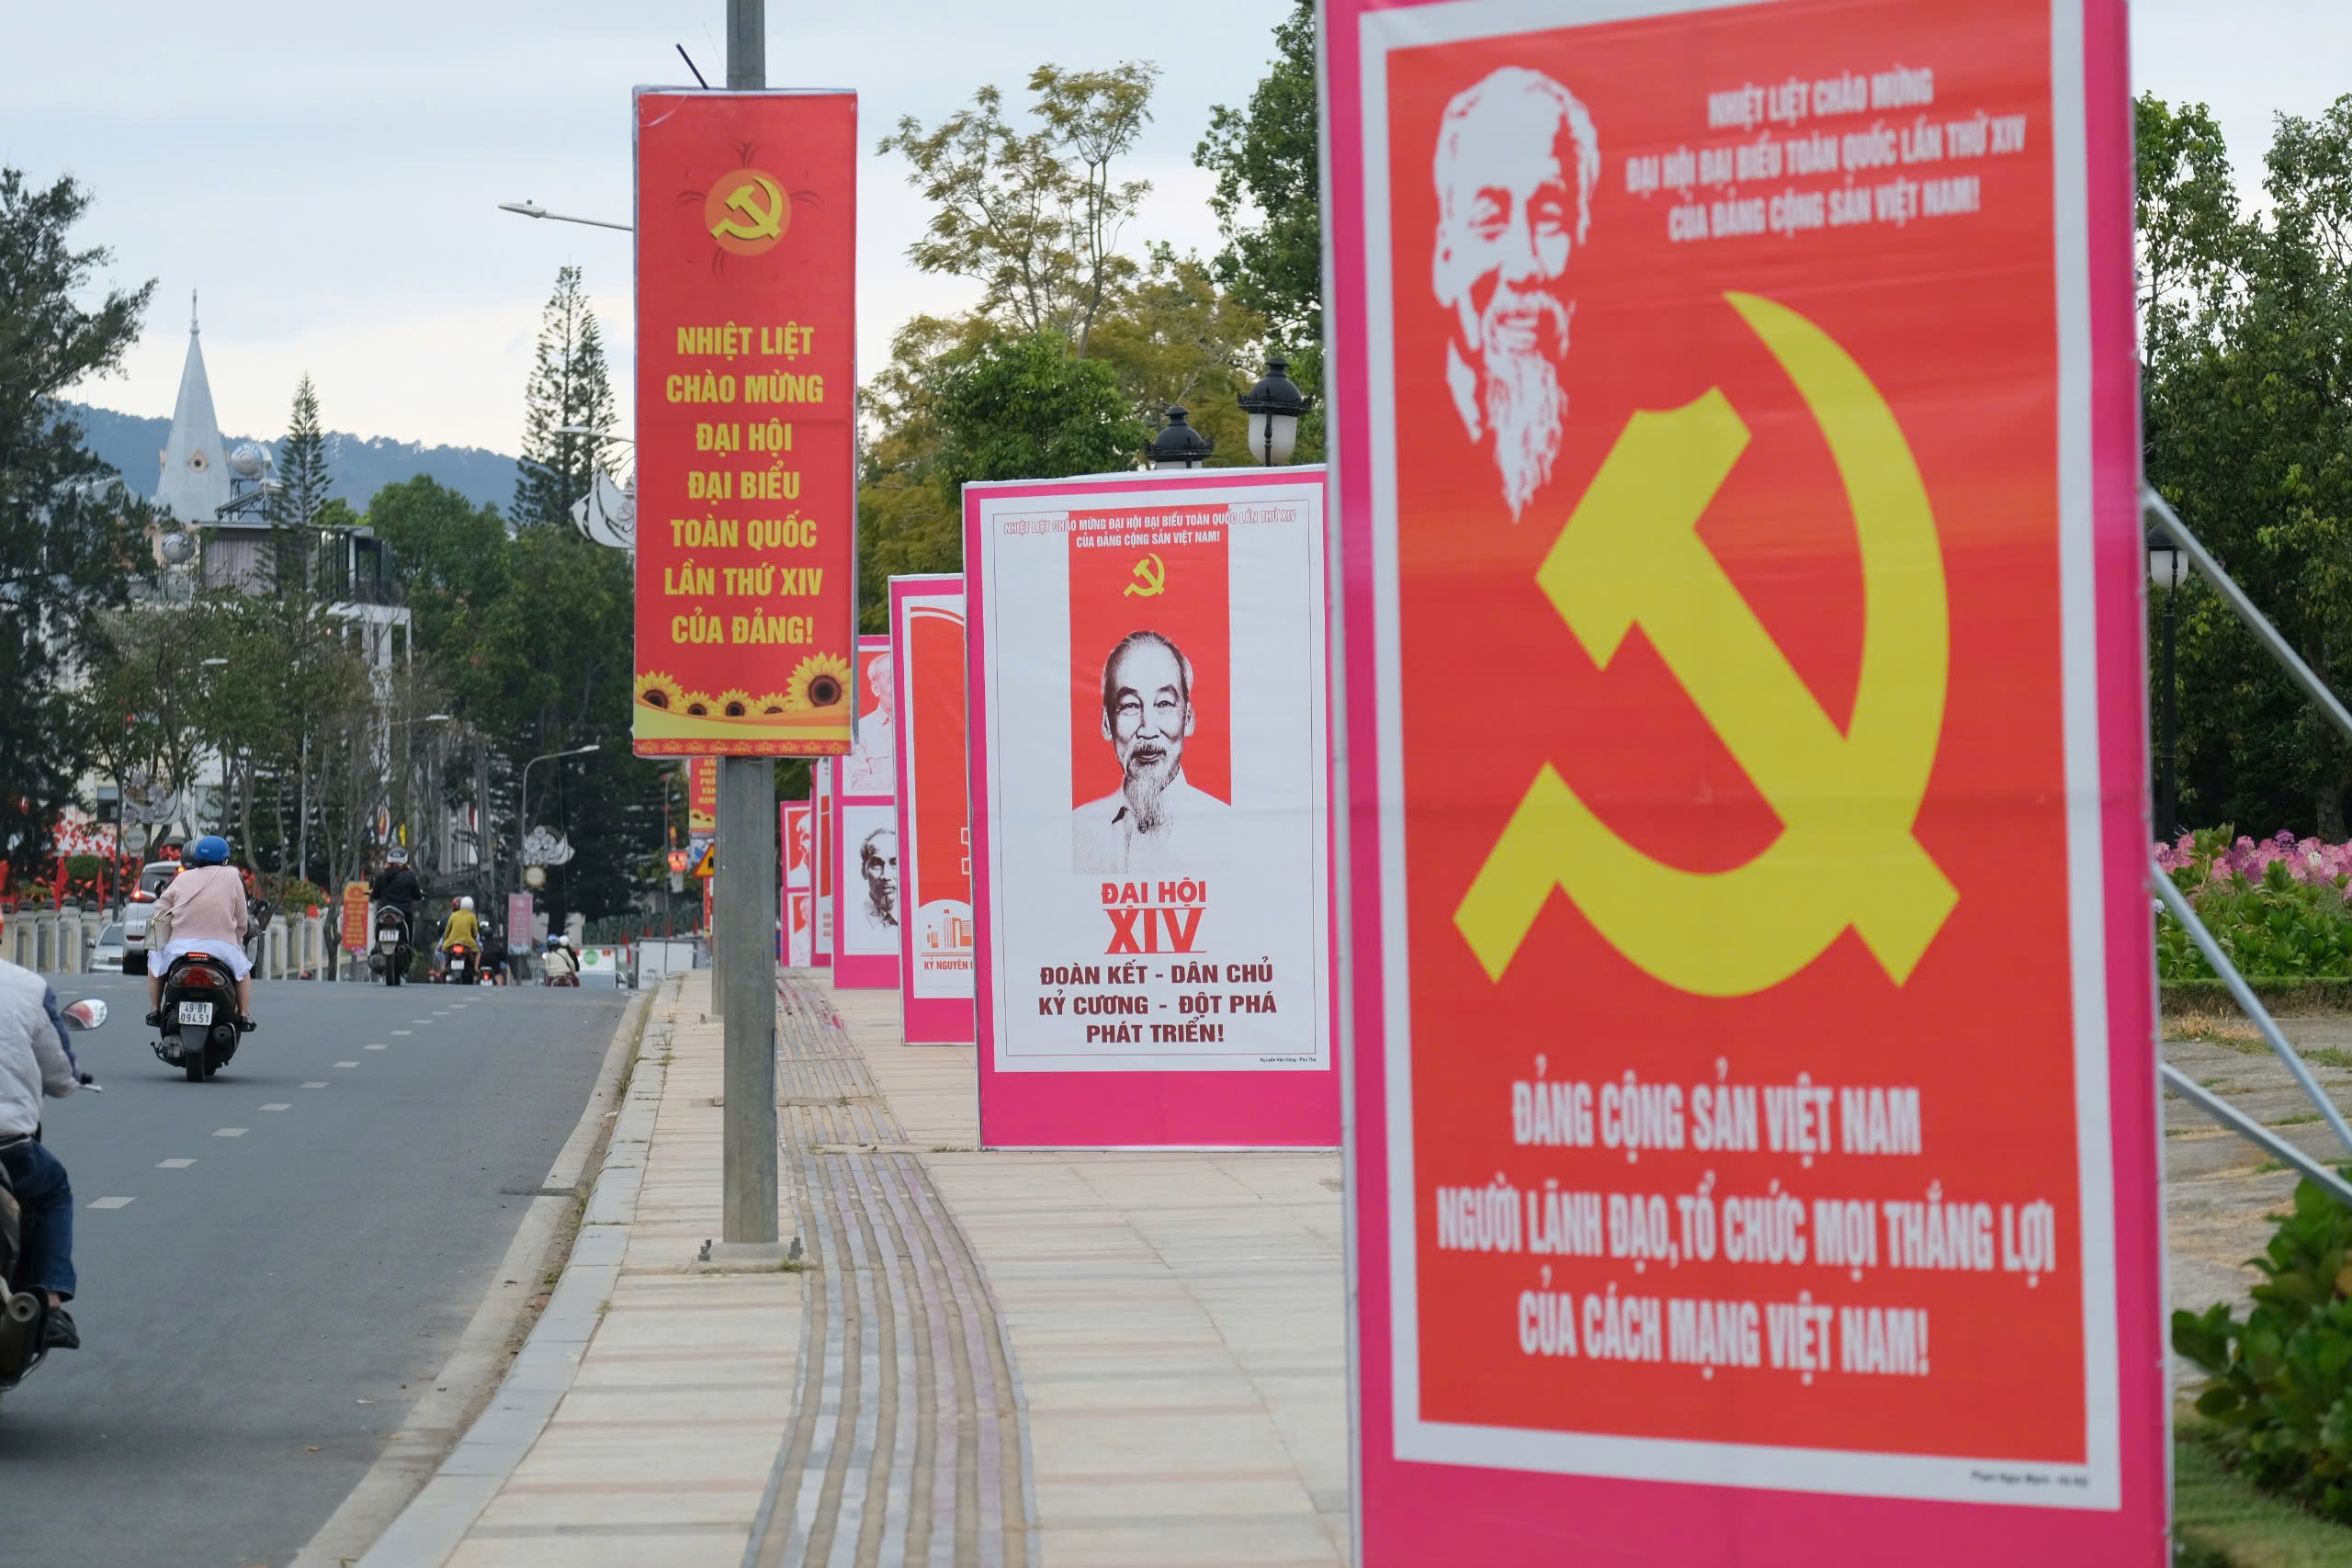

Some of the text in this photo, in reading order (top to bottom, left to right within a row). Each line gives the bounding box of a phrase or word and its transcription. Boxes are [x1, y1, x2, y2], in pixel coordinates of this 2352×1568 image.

[1708, 63, 1934, 131] NHIỆT LIỆT CHÀO MỪNG
[1626, 156, 1658, 198] ĐẠI
[1663, 144, 1696, 196] HỘI
[1700, 147, 1733, 191] ĐẠI
[1785, 131, 1838, 175] TOÀN
[1841, 118, 1897, 174] QUỐC
[1991, 115, 2026, 153] XIV
[1668, 173, 1980, 241] CỦA ĐẢNG CỘNG SẢN VIỆT NAM!
[677, 321, 814, 361] NHIỆT LIỆT
[666, 368, 823, 403] CHÀO MỪNG
[695, 417, 792, 457] ĐẠI HỘI
[688, 460, 799, 505] ĐẠI BIỂU
[670, 510, 817, 551] TOÀN QUỐC
[1004, 507, 1296, 536] NHIỆT LIỆT CHÀO MỪNG ĐẠI HỘI ĐẠI BIỂU TOÀN QUỐC LẦN THỨ XIV
[1076, 529, 1220, 547] CỦA ĐẢNG CỘNG SẢN VIỆT NAM!
[664, 558, 823, 595] LẦN THỨ XIV
[672, 606, 813, 644] CỦA ĐẢNG!
[1102, 877, 1206, 908] ĐẠI HỘI
[1102, 908, 1206, 954] XIV
[936, 958, 968, 970] NGUYÊN
[1040, 963, 1100, 986] ĐOÀN
[1108, 960, 1148, 984] KẾT
[1171, 961, 1218, 984] DÂN
[1227, 956, 1272, 984] CHỦ
[180, 1013, 210, 1023] 094.51
[184, 1003, 208, 1013] 49-B1
[1039, 988, 1066, 1015] KỶ
[1073, 995, 1148, 1015] CƯƠNG
[1179, 992, 1222, 1018] ĐỘT
[1230, 990, 1277, 1013] PHÁ
[1087, 1016, 1224, 1043] PHÁT TRIỂN!
[1512, 1053, 1921, 1168] ĐẢNG CỘNG SẢN VIỆT NAM
[1436, 1170, 1521, 1253] NGƯỜI
[1527, 1178, 1603, 1257] LÃNH
[1723, 1179, 1806, 1265] CHỨC
[1814, 1198, 1877, 1282] MỌI
[1883, 1179, 1994, 1271] THẮNG
[2001, 1199, 2055, 1288] LỢI
[1518, 1263, 1928, 1385] CỦA CÁCH MẠNG VIỆT NAM!
